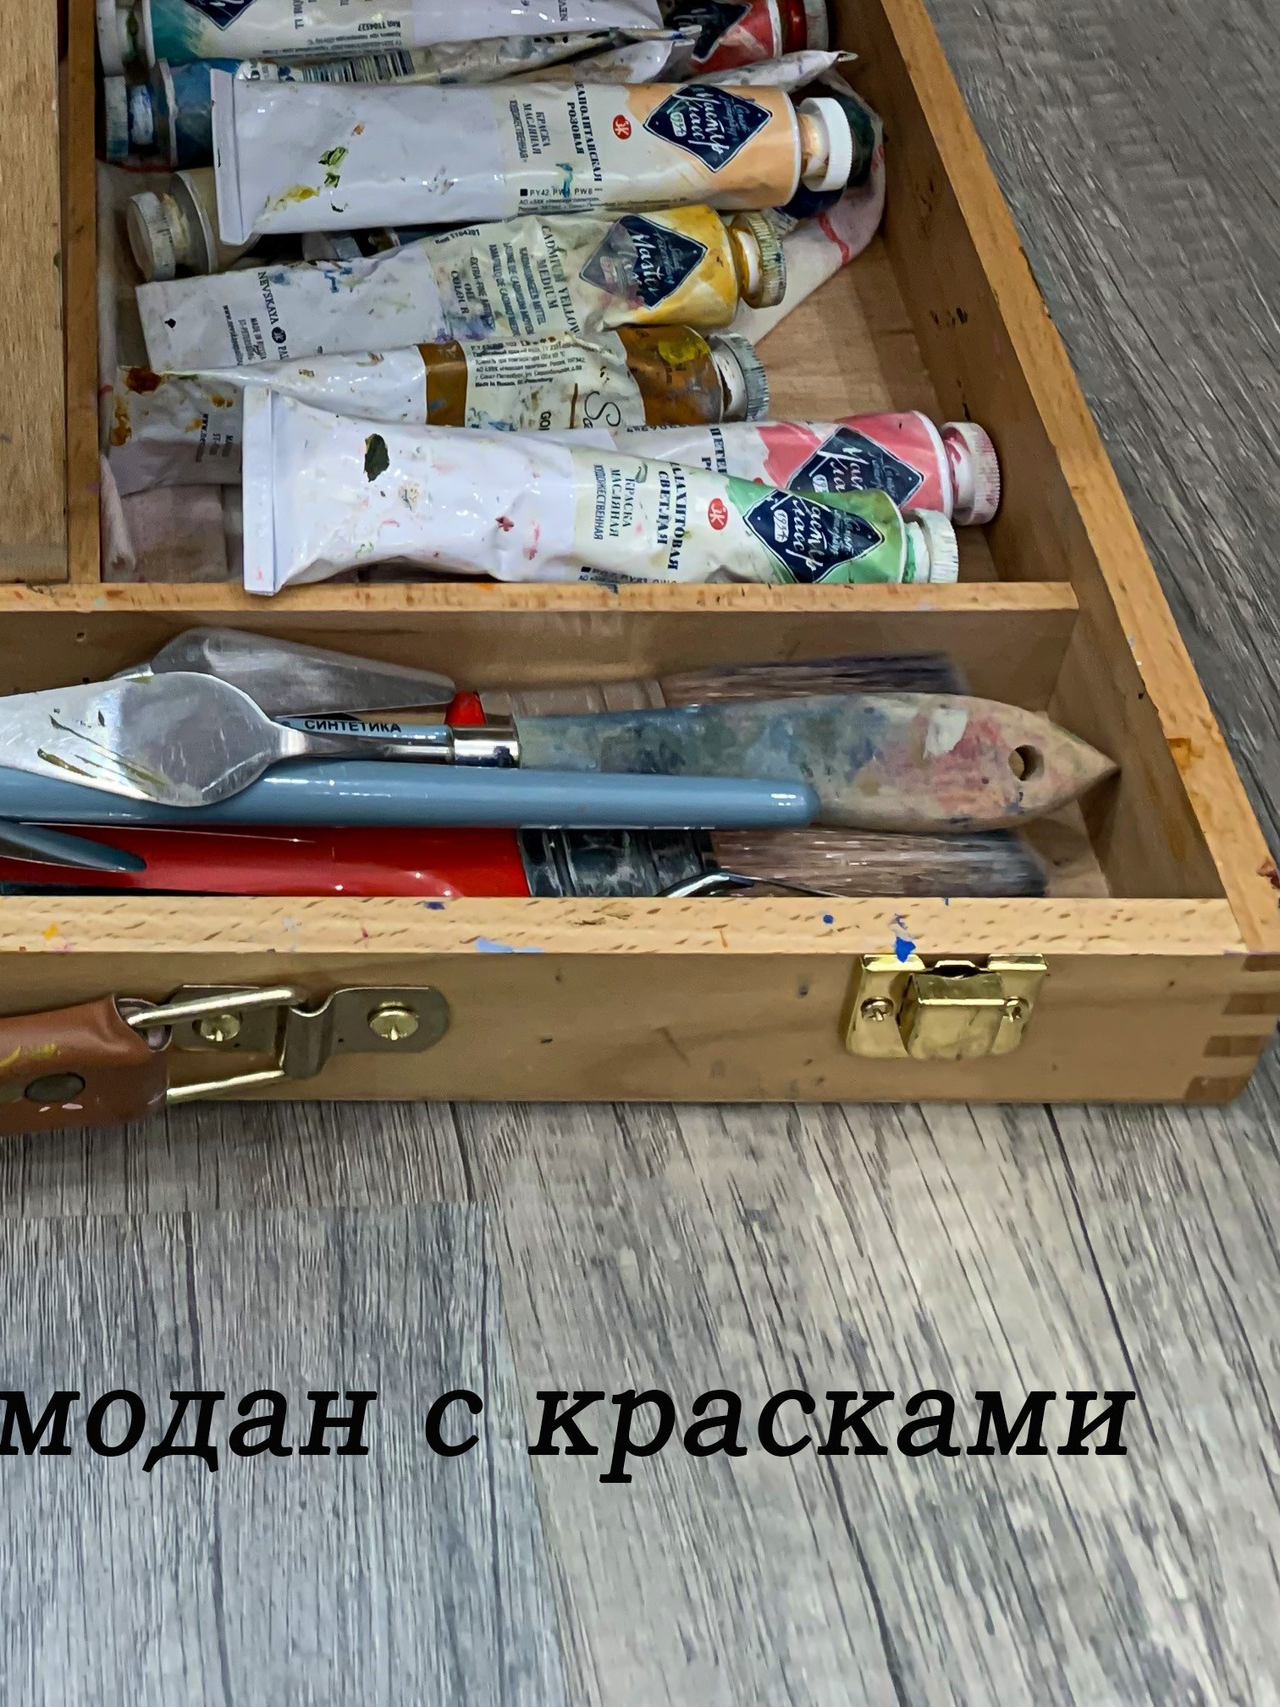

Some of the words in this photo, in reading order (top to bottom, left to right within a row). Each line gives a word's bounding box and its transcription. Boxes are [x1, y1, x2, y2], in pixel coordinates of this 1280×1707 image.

[522, 103, 542, 155] МАСЛЯНАЯ
[535, 111, 551, 148] КРАСКА
[567, 101, 585, 155] РОЗОВАЯ
[258, 271, 279, 325] NEVSKAYA
[451, 270, 470, 314] COLOUR
[536, 258, 559, 310] MEDIUM
[541, 225, 568, 283] CADMIUM
[558, 286, 581, 336] YELLOW
[592, 464, 609, 541] ХУДОЖЕСТВЕННАЯ
[609, 468, 622, 538] МАСЛЯНАЯ
[622, 477, 635, 528] КРАСКА
[657, 470, 672, 545] СВЕТЛАЯ
[304, 719, 402, 733] СИНТЕТИКА
